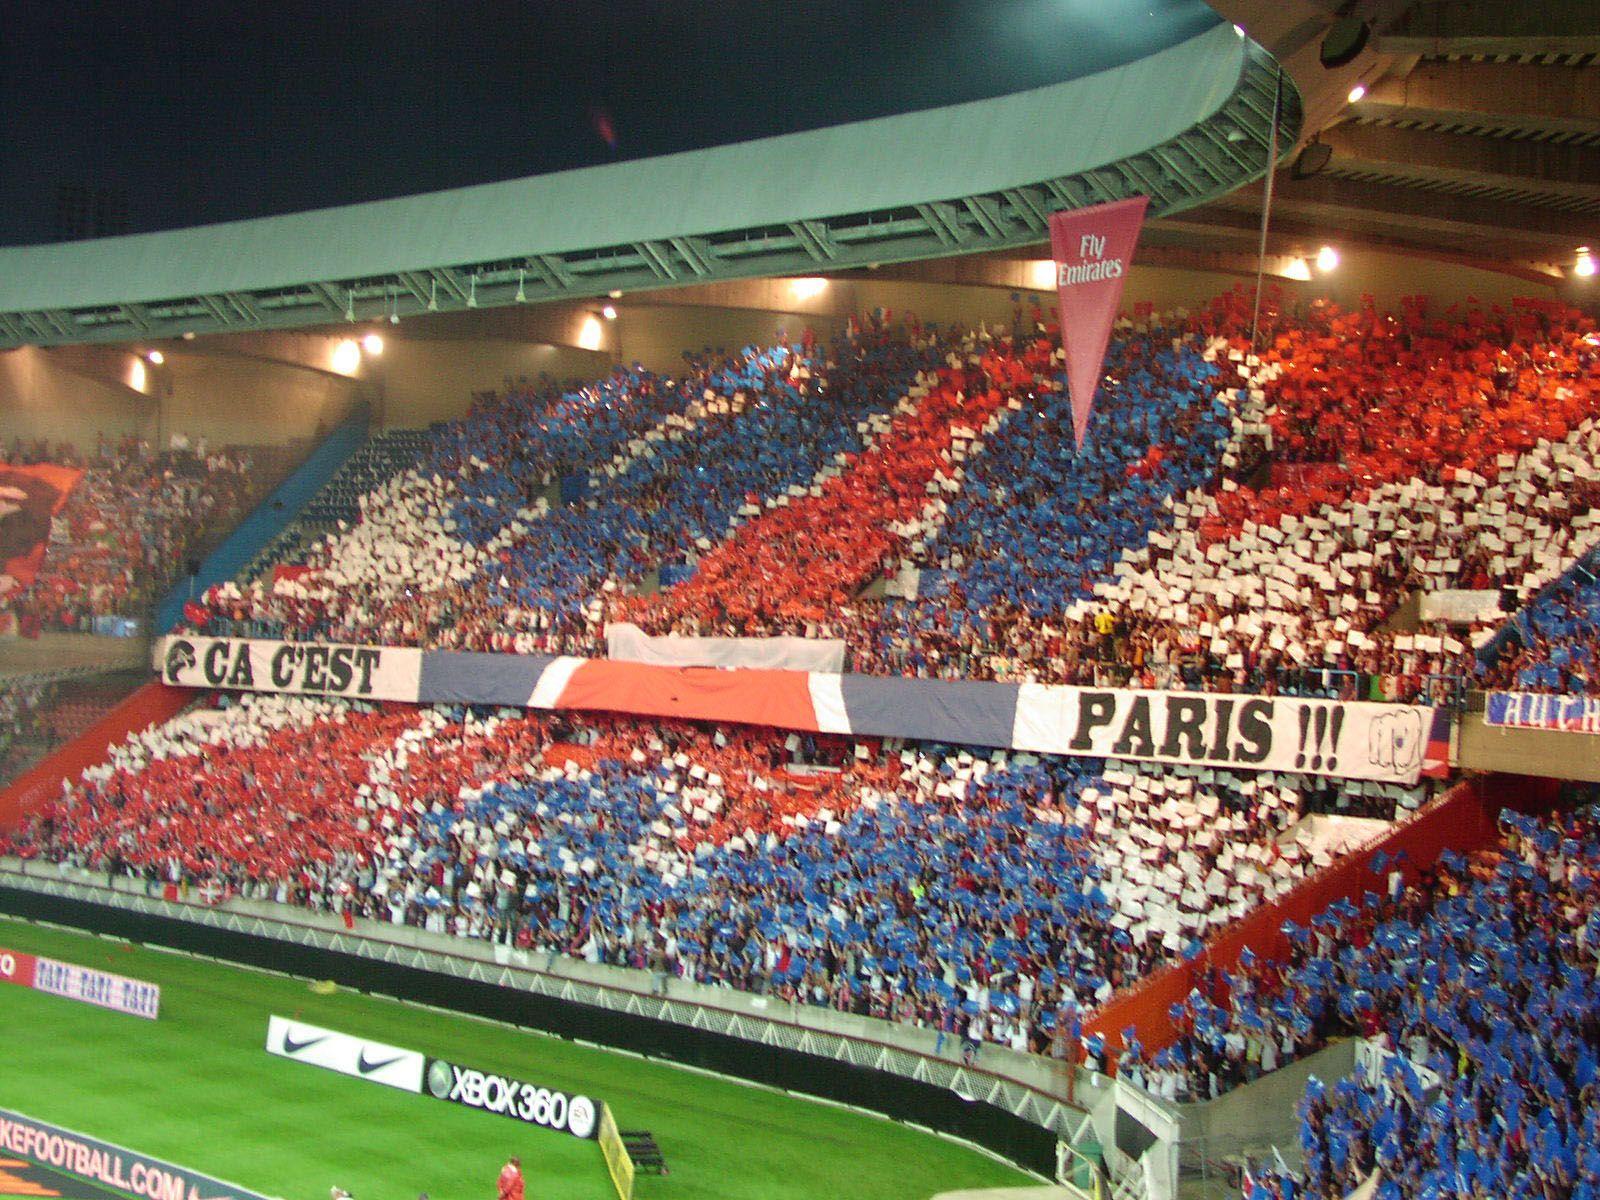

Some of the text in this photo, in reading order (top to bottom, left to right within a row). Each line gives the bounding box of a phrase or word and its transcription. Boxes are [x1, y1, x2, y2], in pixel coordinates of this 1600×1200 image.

[1058, 259, 1122, 286] Emirates
[1080, 234, 1106, 258] Fly
[204, 641, 380, 694] CA C'EST
[1069, 692, 1345, 771] PARIS !!!
[450, 1066, 568, 1129] XBOX 360
